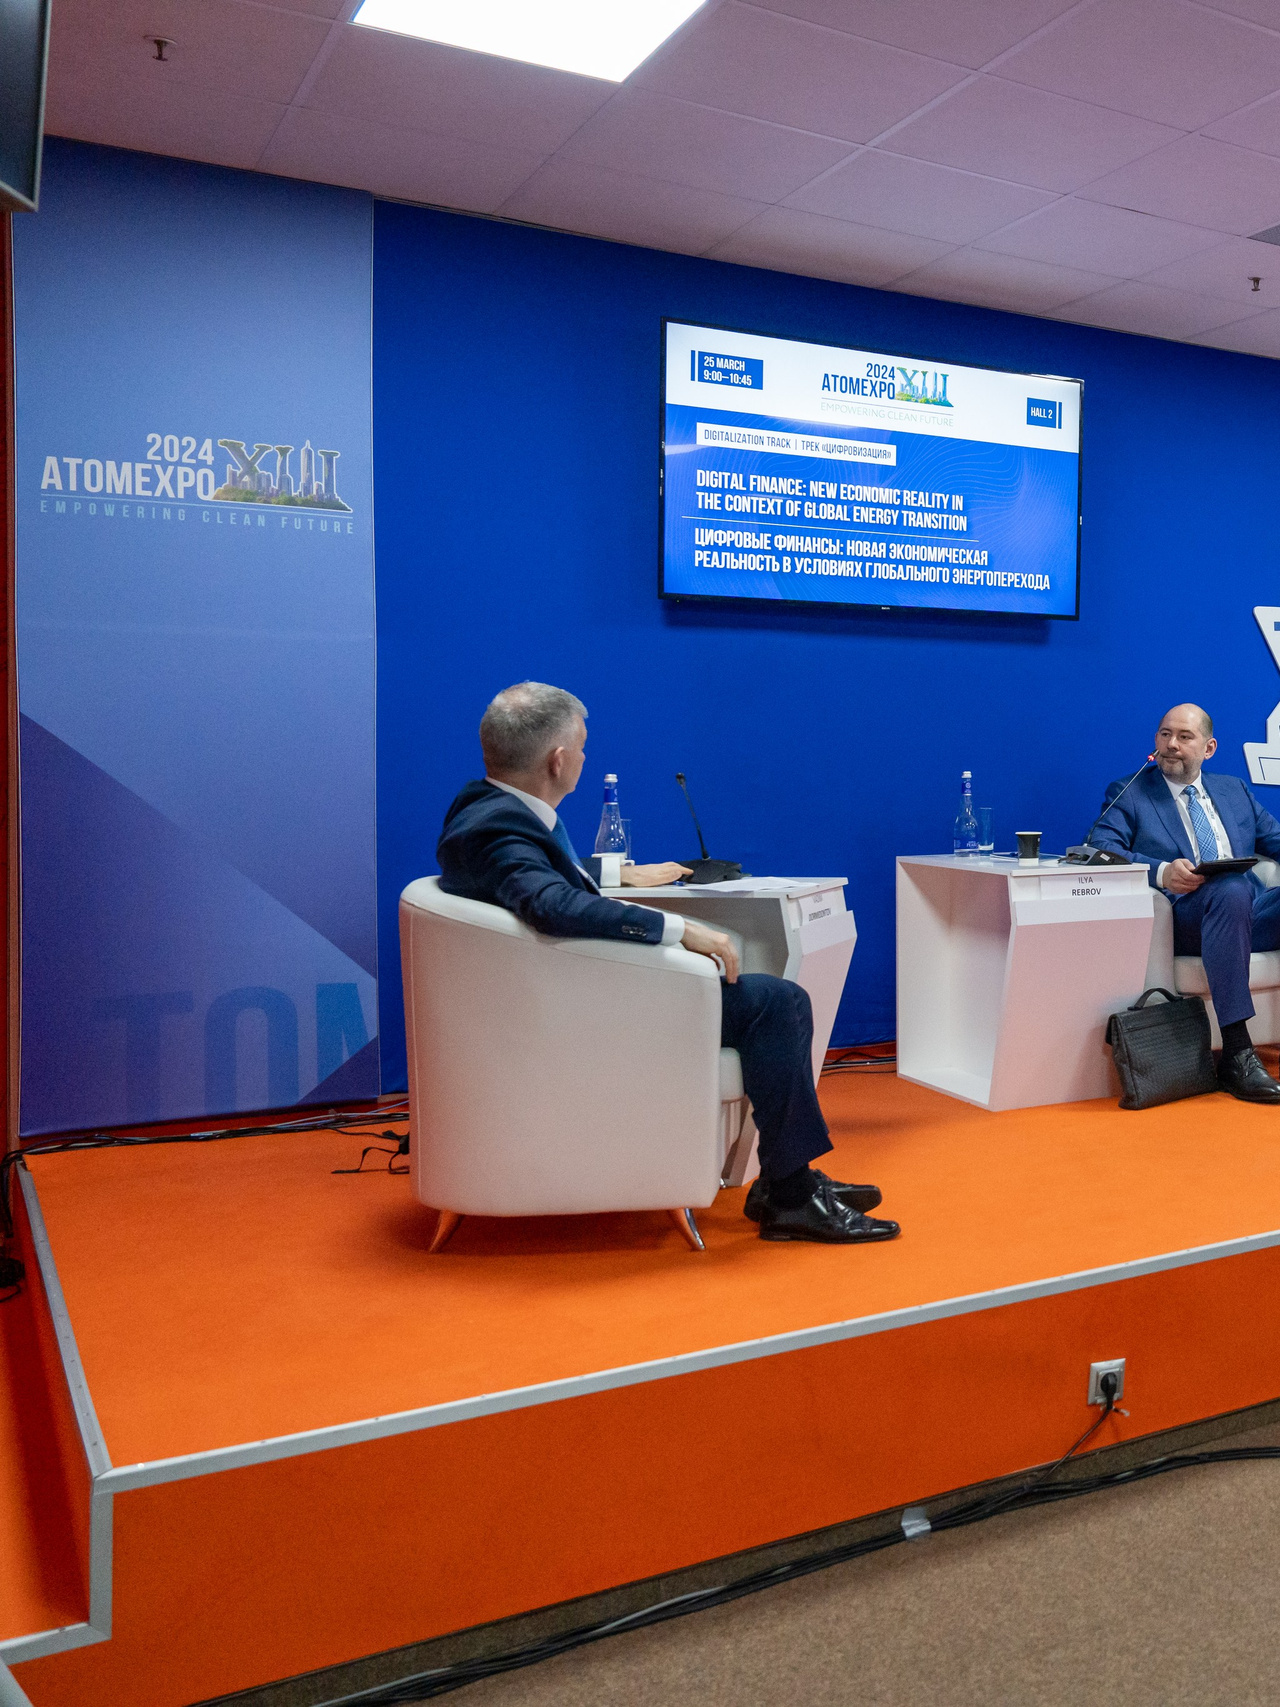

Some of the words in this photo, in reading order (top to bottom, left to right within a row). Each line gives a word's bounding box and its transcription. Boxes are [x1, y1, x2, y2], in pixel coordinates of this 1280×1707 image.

[704, 356, 714, 368] 25
[716, 357, 745, 372] MARCH
[866, 362, 895, 380] 2024
[821, 373, 896, 400] ATOMEXPO
[820, 402, 886, 419] EMPOWERING
[887, 410, 917, 423] CLEAN
[920, 416, 954, 427] FUTURE
[1031, 406, 1047, 419] HALL
[1048, 409, 1053, 419] 2
[147, 433, 215, 465] 2024
[704, 429, 764, 446] DIGITALIZATION
[766, 436, 791, 449] TRACK
[801, 440, 820, 452] ТРЕК
[821, 443, 892, 459] «ЦИФРОВИЗАЦИЯ»
[41, 456, 215, 501] ATOMEXPO
[696, 469, 747, 491] DIGITAL
[750, 474, 807, 496] FINANCE:
[809, 480, 838, 499] NEW
[840, 483, 901, 505] ECONOMIC
[903, 490, 949, 510] REALITY
[951, 494, 963, 511] IN
[40, 500, 186, 521] EMPOWERING
[202, 510, 265, 527] CLEAN
[281, 516, 353, 534] FUTURE
[695, 491, 722, 511] THE
[724, 494, 783, 515] CONTEXT
[785, 500, 802, 517] OF
[804, 501, 850, 521] GLOBAL
[853, 506, 899, 526] ENERGY
[901, 510, 967, 531] TRANSITION
[695, 527, 772, 550] ЦИФРОВЫЕ
[774, 534, 844, 555] ФИНАНСЫ:
[846, 540, 886, 558] НОВАЯ
[889, 543, 988, 566] ЭКОНОМИЧЕСКАЯ
[695, 550, 780, 572] РЕАЛЬНОСТЬ
[782, 556, 792, 573] В
[794, 557, 863, 578] УСЛОВИЯХ
[865, 562, 950, 583] ГЛОБАЛЬНОГО
[952, 568, 1050, 591] ЭНЕРГОПЕРЕХОДА
[1071, 888, 1102, 897] REBROV
[1078, 876, 1094, 884] ILYA
